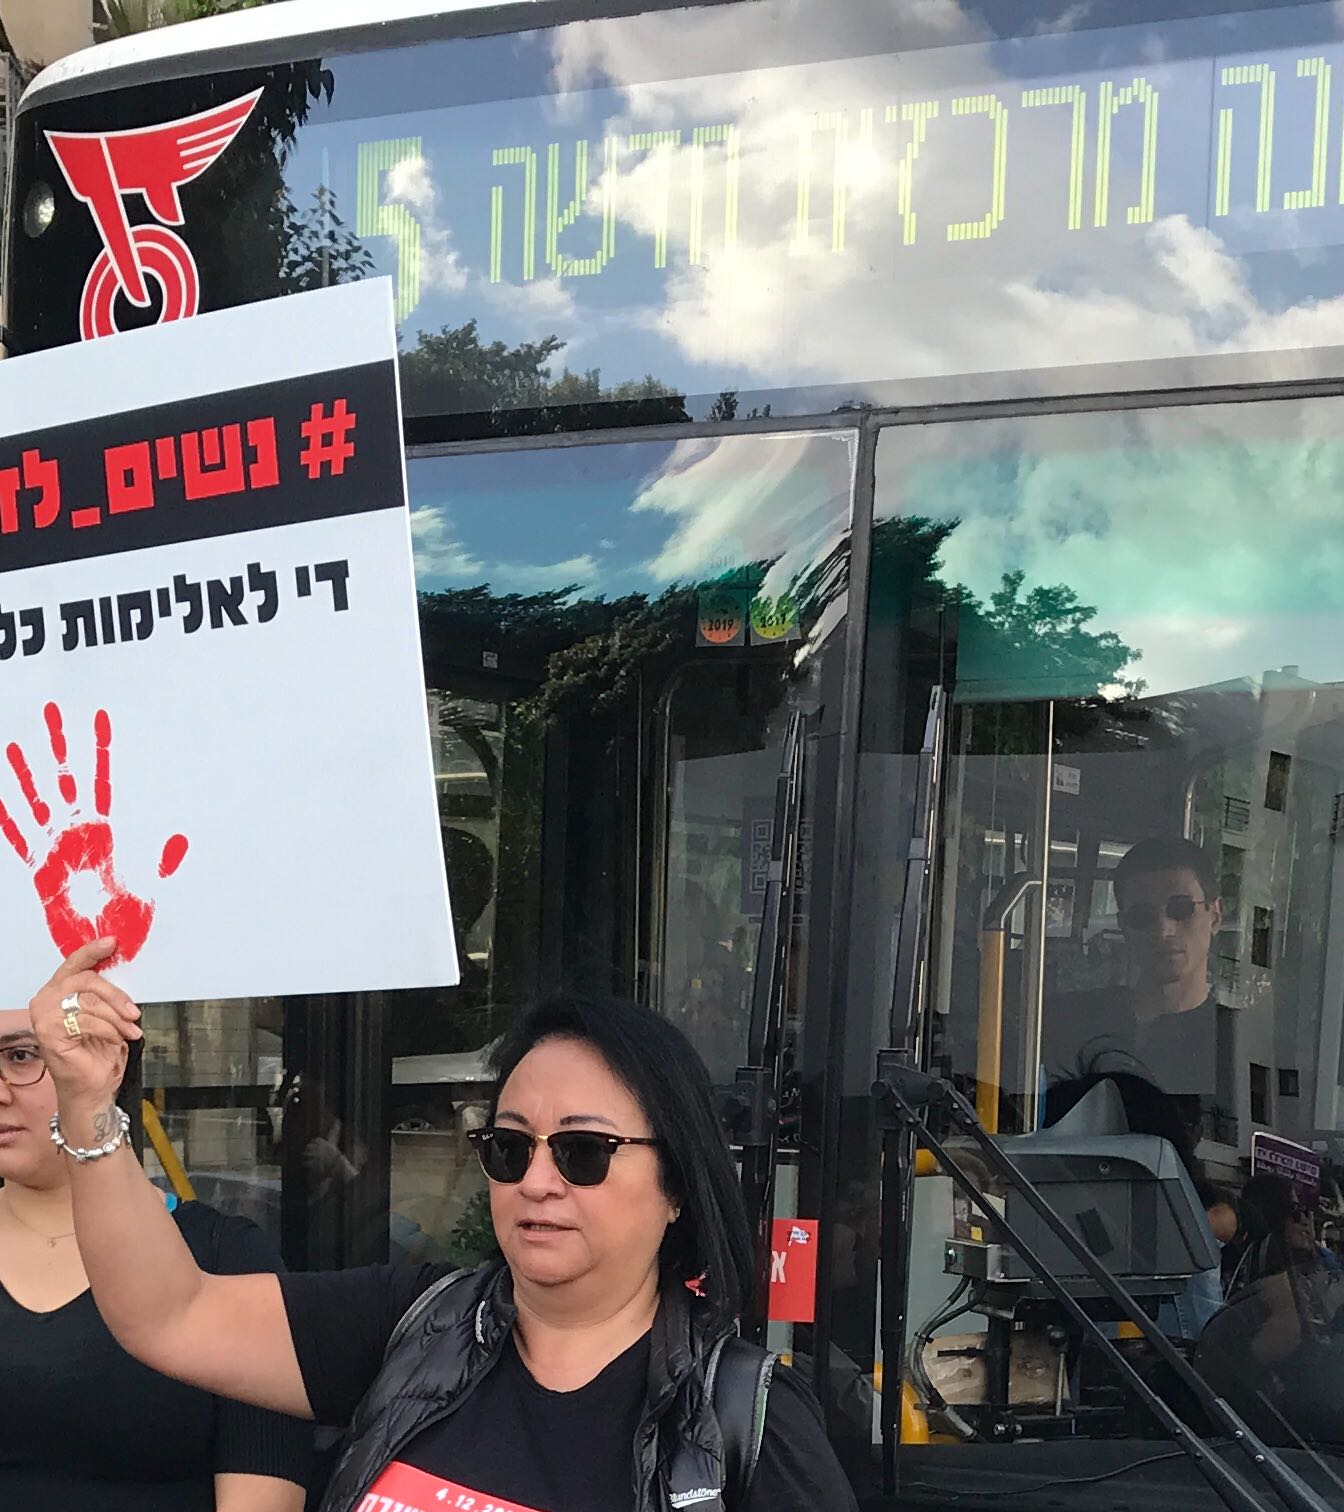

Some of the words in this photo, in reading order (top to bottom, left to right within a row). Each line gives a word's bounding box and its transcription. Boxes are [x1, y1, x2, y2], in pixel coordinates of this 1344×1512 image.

[357, 136, 422, 325] 5
[491, 124, 739, 283] חדשה
[790, 78, 1158, 255] מרכזית
[60, 562, 280, 652] לאלימות
[295, 558, 351, 613] די
